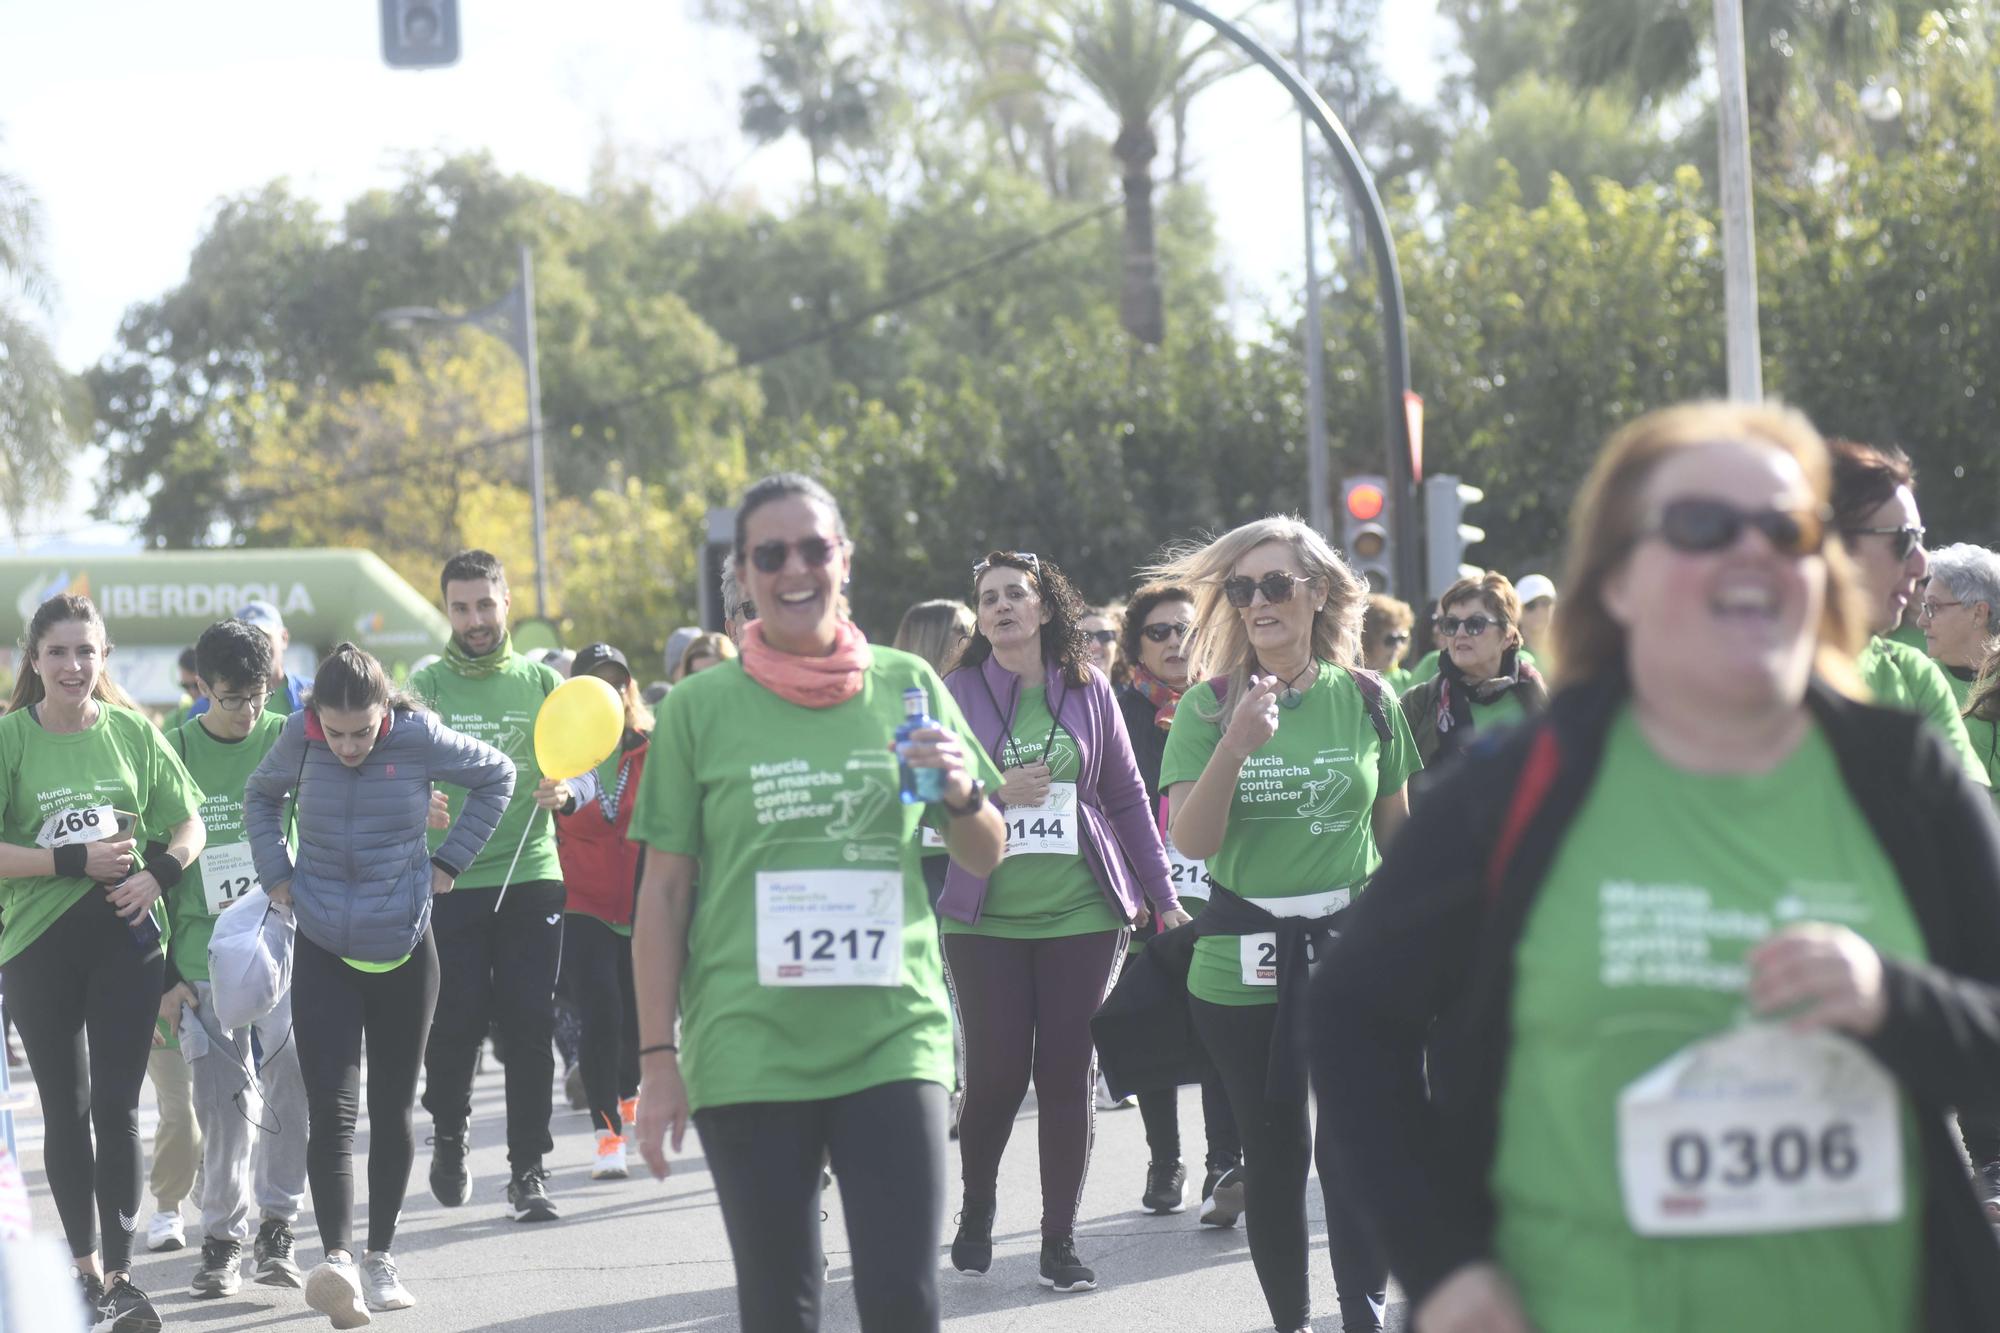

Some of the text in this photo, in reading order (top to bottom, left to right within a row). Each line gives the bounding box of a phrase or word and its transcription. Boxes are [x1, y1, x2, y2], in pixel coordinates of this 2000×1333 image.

[451, 713, 482, 722] Murcia
[465, 721, 500, 730] marcha
[750, 758, 809, 779] Murcia
[1240, 765, 1311, 779] en marcha
[752, 772, 844, 795] en marcha
[1240, 780, 1283, 791] contra
[37, 787, 72, 802] Murcia
[40, 792, 93, 811] en marcha
[205, 793, 229, 804] urcia
[753, 789, 812, 809] contra
[1241, 790, 1303, 803] el cáncer
[201, 814, 228, 823] ontra
[757, 803, 835, 825] el cáncer
[208, 821, 241, 832] cáncer
[784, 928, 886, 961] 1217
[1668, 1121, 1861, 1189] 0306
